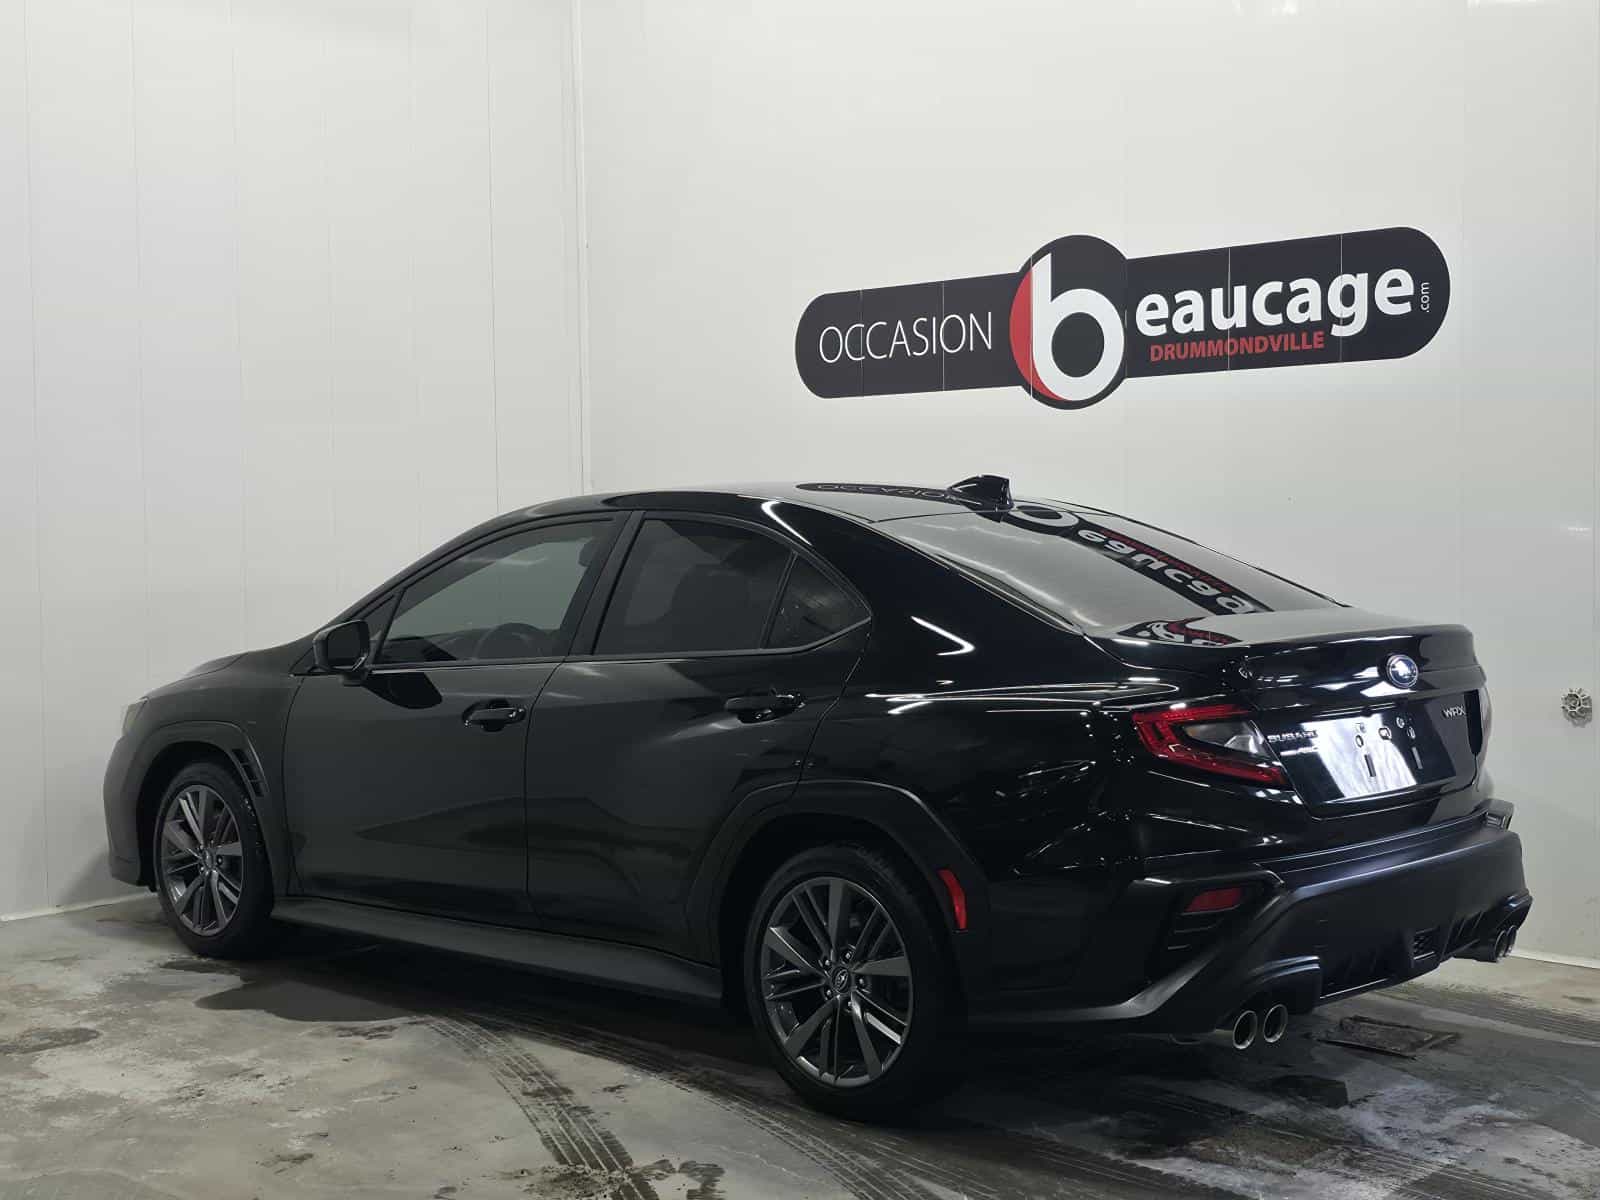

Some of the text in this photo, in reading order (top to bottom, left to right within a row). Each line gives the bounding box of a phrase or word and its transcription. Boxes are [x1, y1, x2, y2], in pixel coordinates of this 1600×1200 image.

[1420, 281, 1430, 312] .com
[819, 311, 991, 363] OCCASION
[1150, 330, 1325, 362] DRUMMONDVILLE
